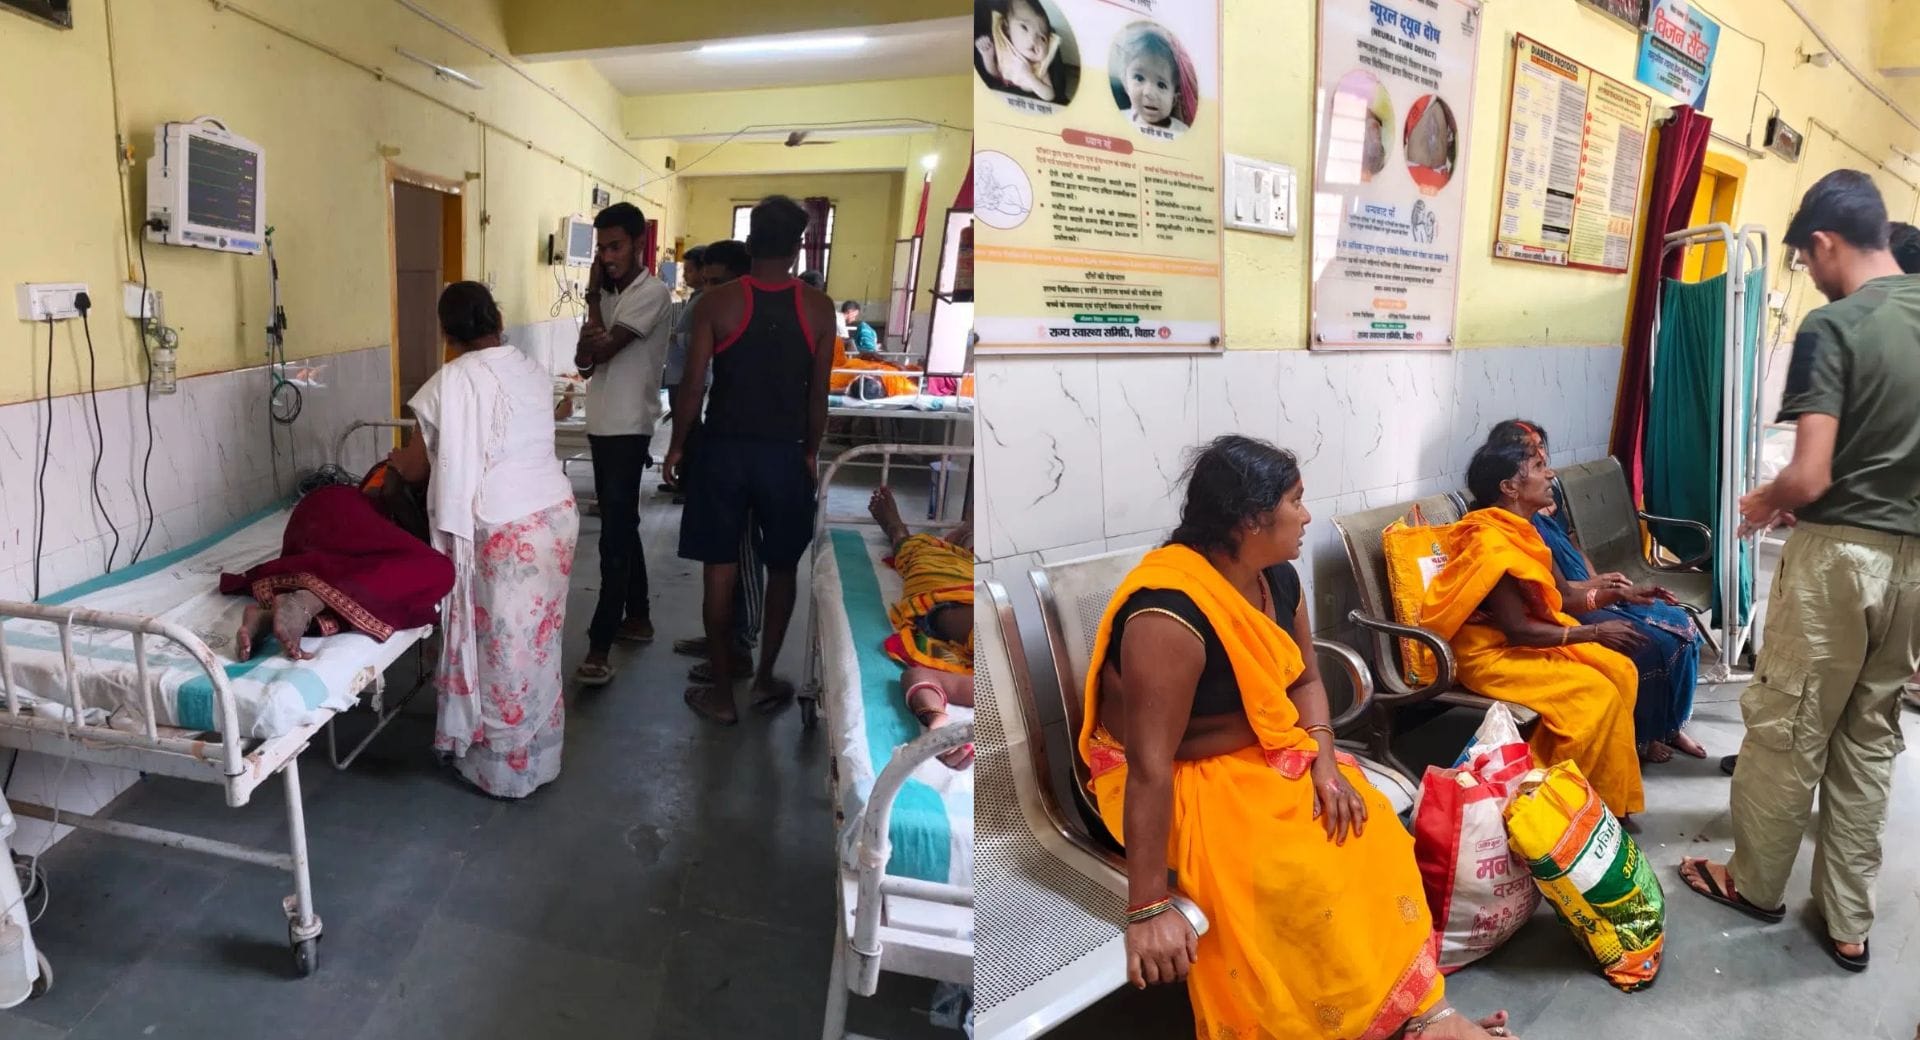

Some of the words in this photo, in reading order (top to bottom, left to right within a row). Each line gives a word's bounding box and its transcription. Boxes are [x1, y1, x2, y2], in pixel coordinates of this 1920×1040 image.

[1423, 20, 1441, 44] दोष
[1654, 7, 1686, 48] विजन
[1398, 38, 1413, 51] TUBE
[1531, 45, 1554, 63] DIABETES
[1554, 56, 1578, 74] PROTOCOL
[1049, 327, 1070, 338] राज्य
[1071, 328, 1102, 338] स्वास्थ्य
[1103, 326, 1133, 338] समिति,
[1134, 326, 1156, 338] बिहार
